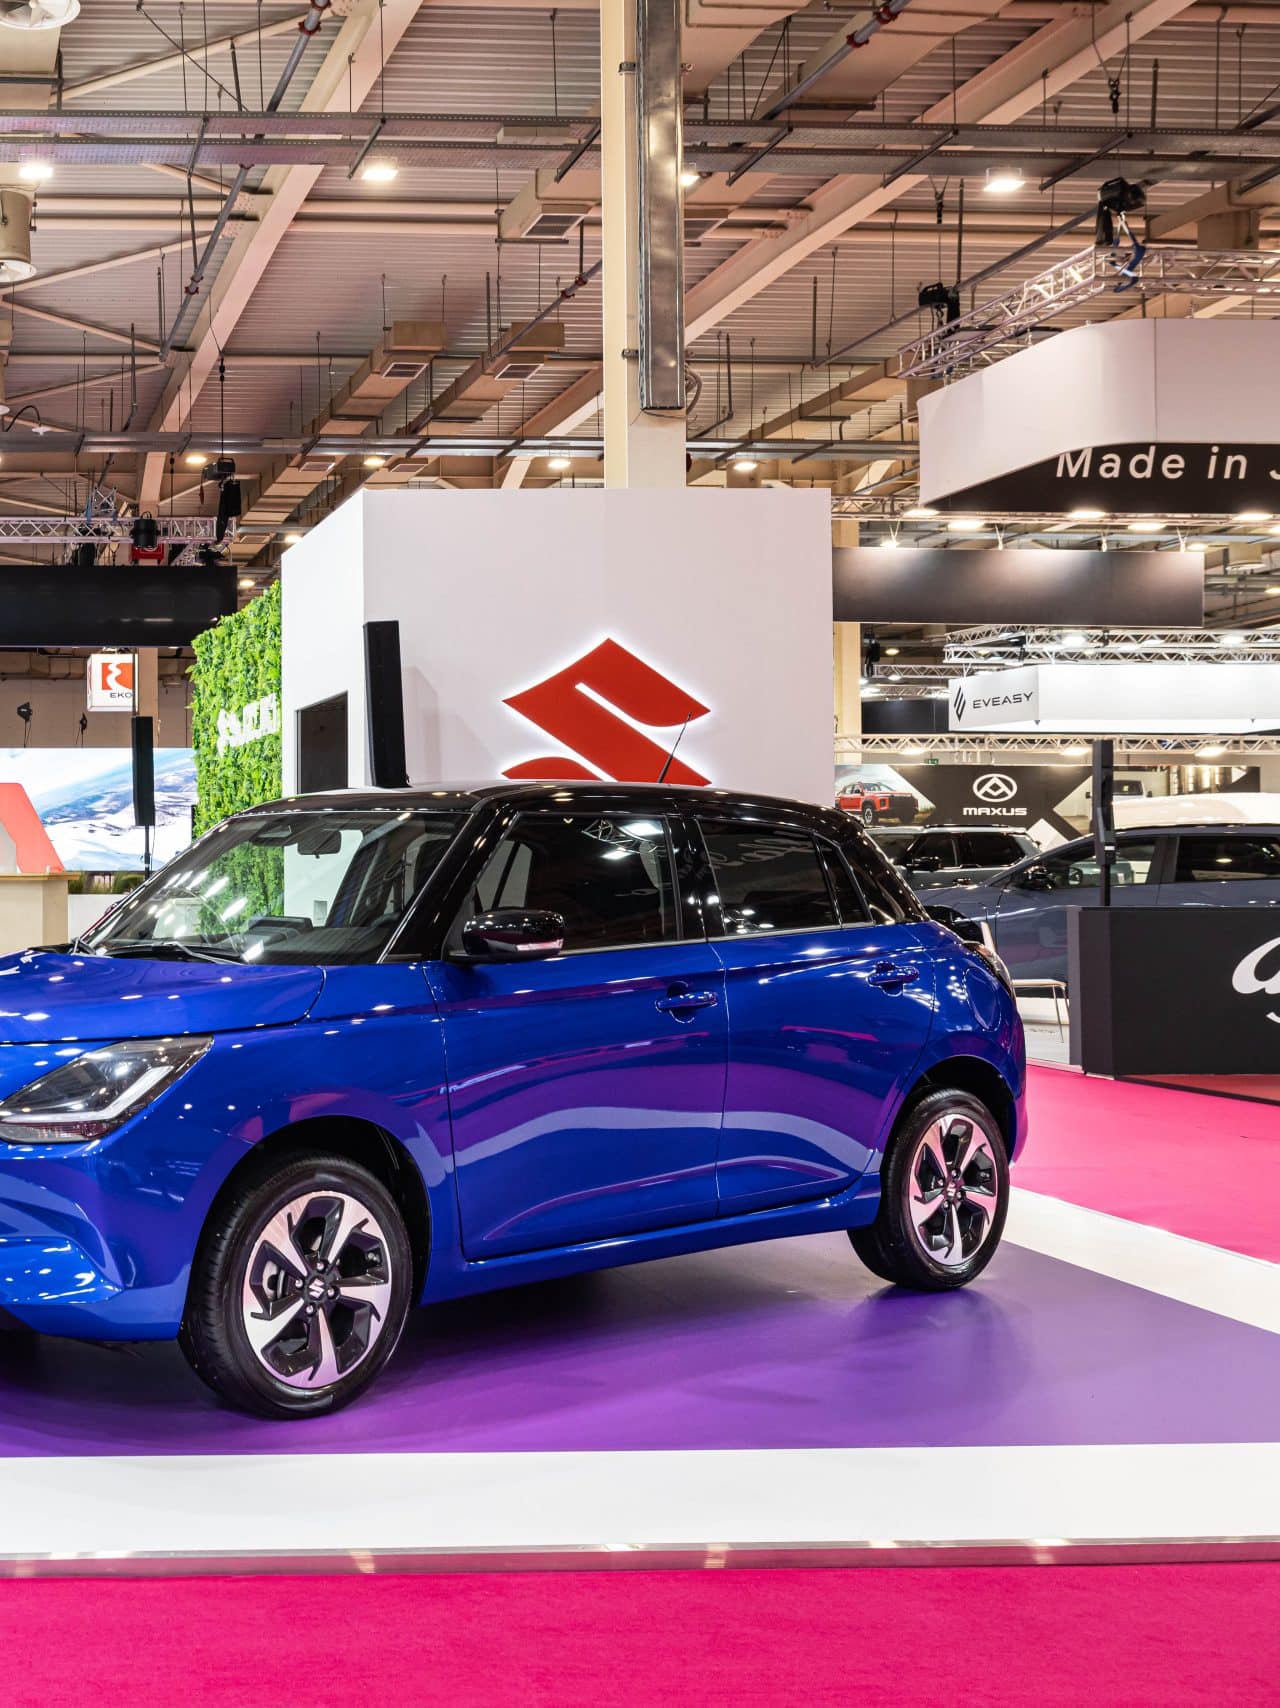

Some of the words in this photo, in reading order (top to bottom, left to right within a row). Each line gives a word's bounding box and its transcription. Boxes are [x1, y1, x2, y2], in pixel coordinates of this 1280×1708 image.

[1056, 445, 1185, 479] Made
[1207, 445, 1247, 479] in
[109, 691, 134, 699] EKO
[972, 692, 1033, 709] EVEASY
[962, 807, 1028, 816] MAXUS
